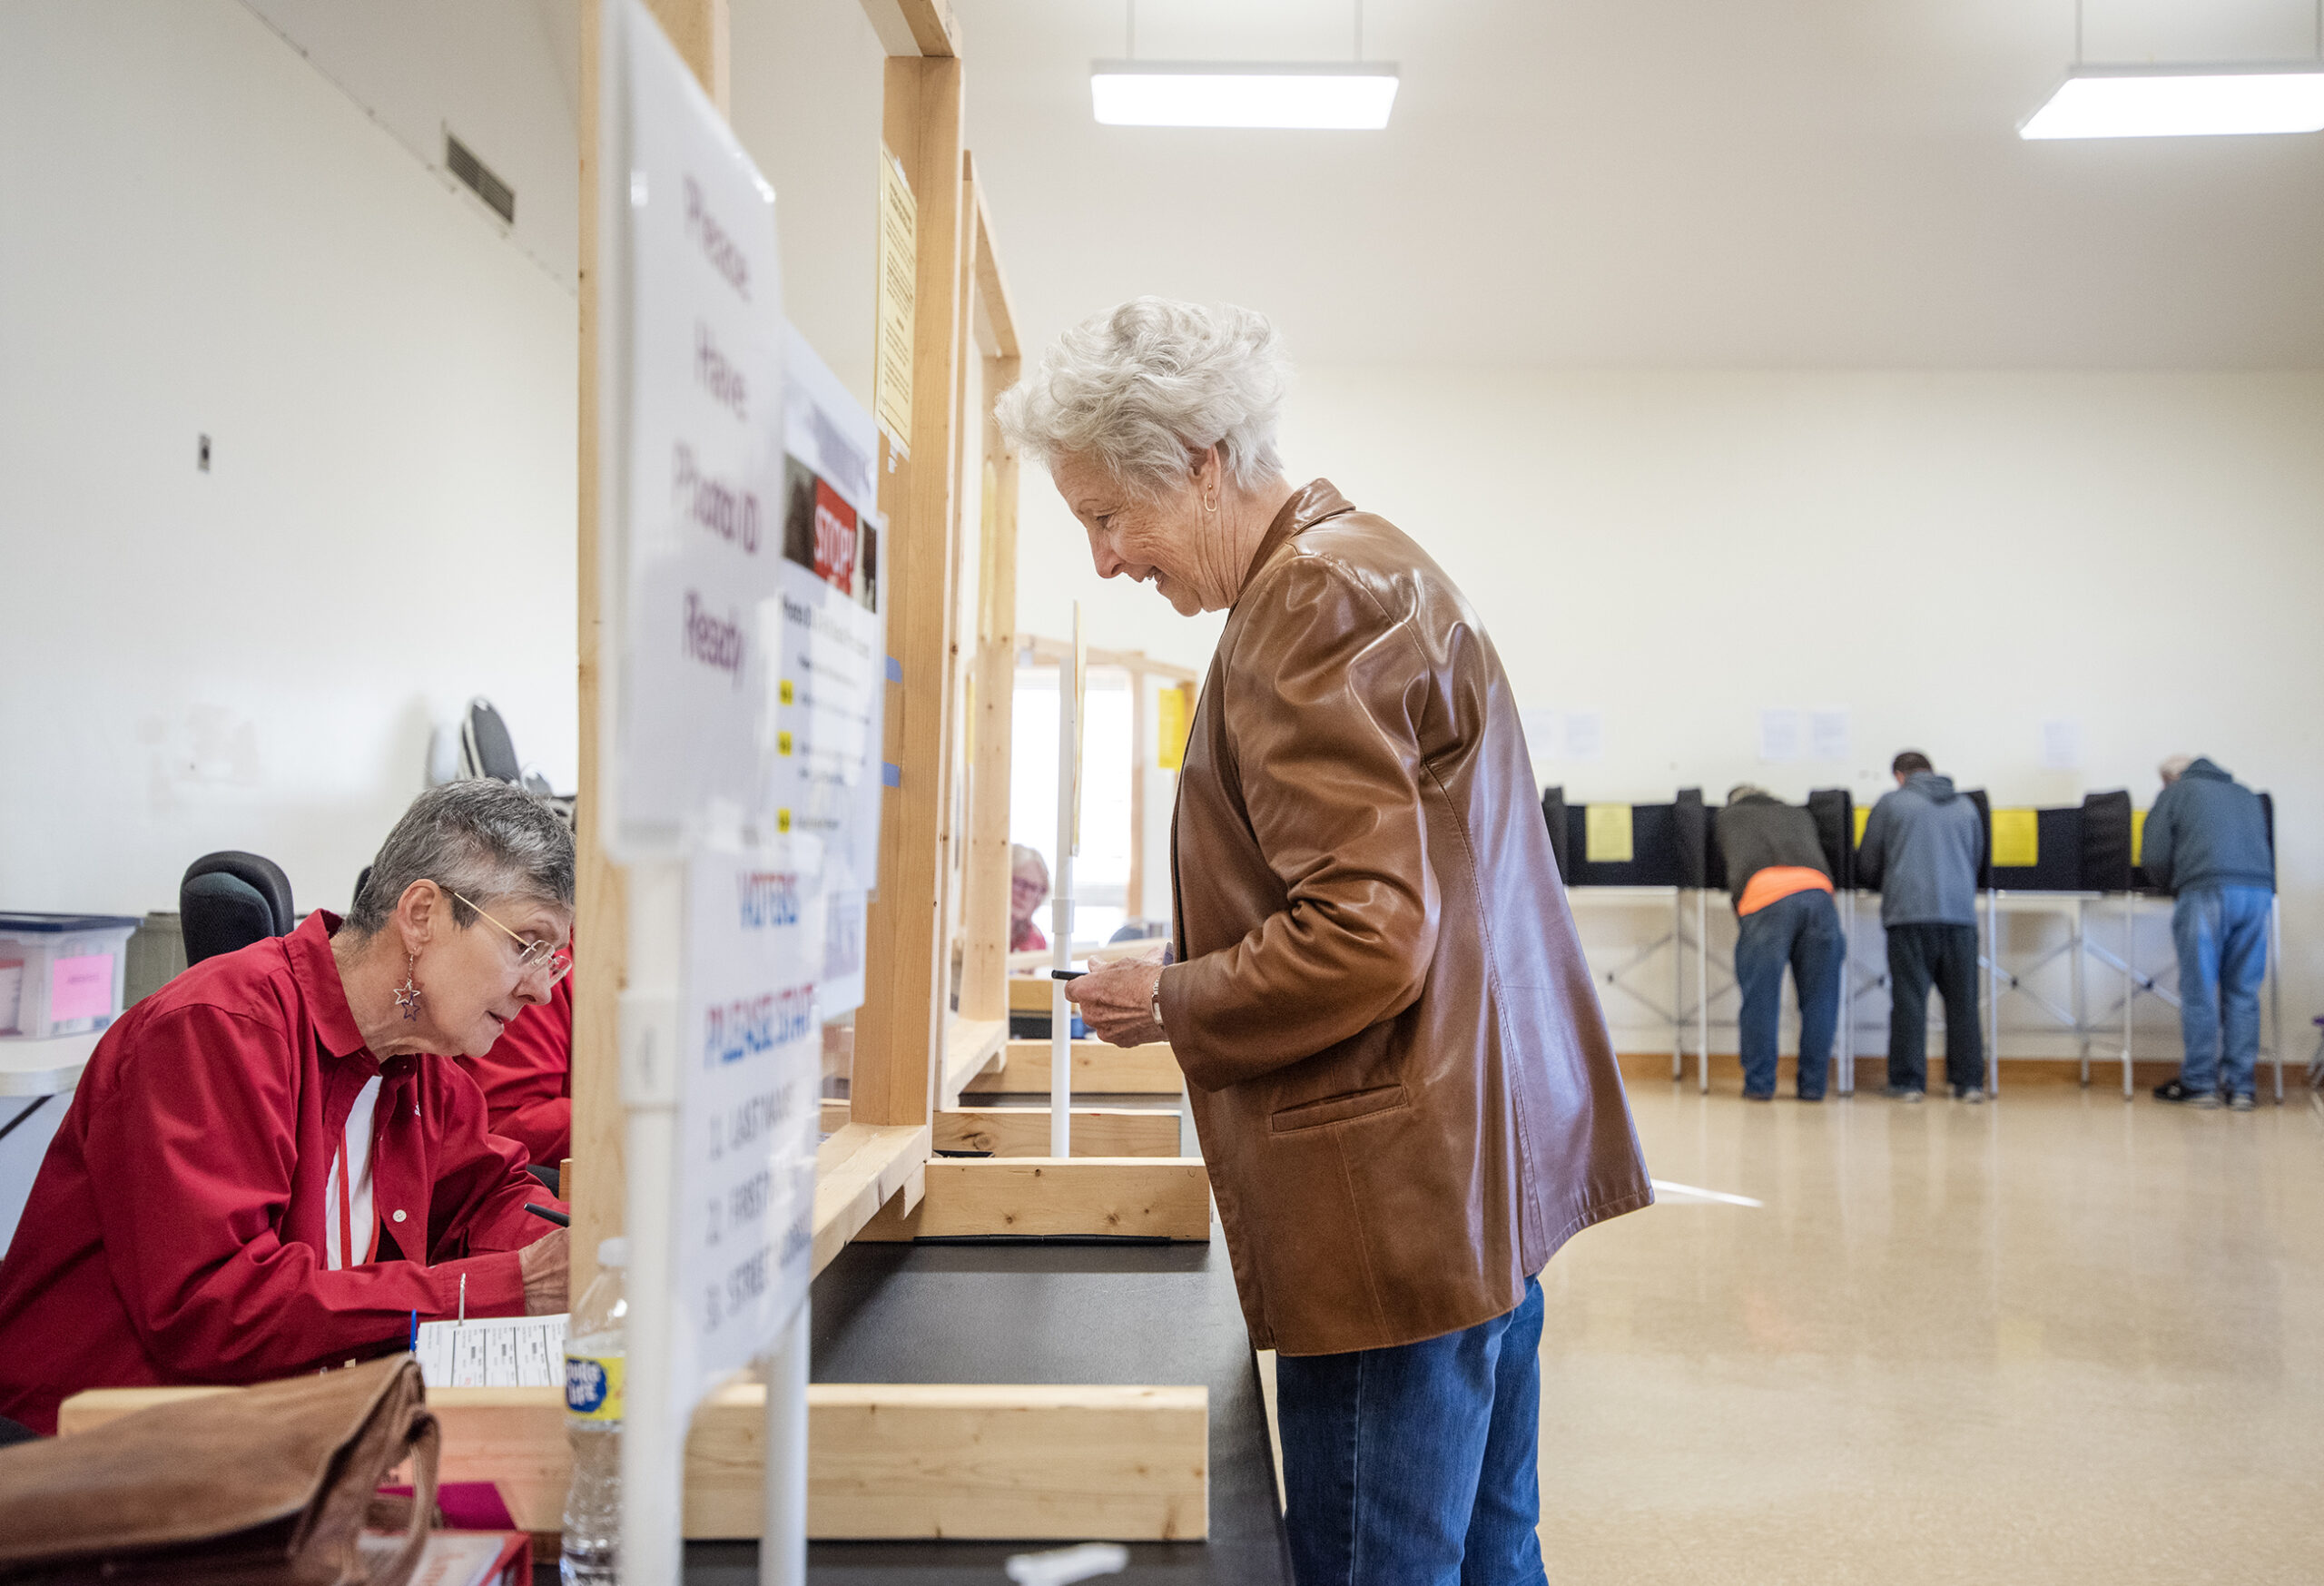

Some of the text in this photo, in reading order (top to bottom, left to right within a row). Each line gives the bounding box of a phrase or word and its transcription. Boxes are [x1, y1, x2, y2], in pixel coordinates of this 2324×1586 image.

[694, 320, 749, 422] Have
[682, 586, 748, 693] Ready
[736, 872, 800, 930] VOTERS
[775, 982, 816, 1044] STAT
